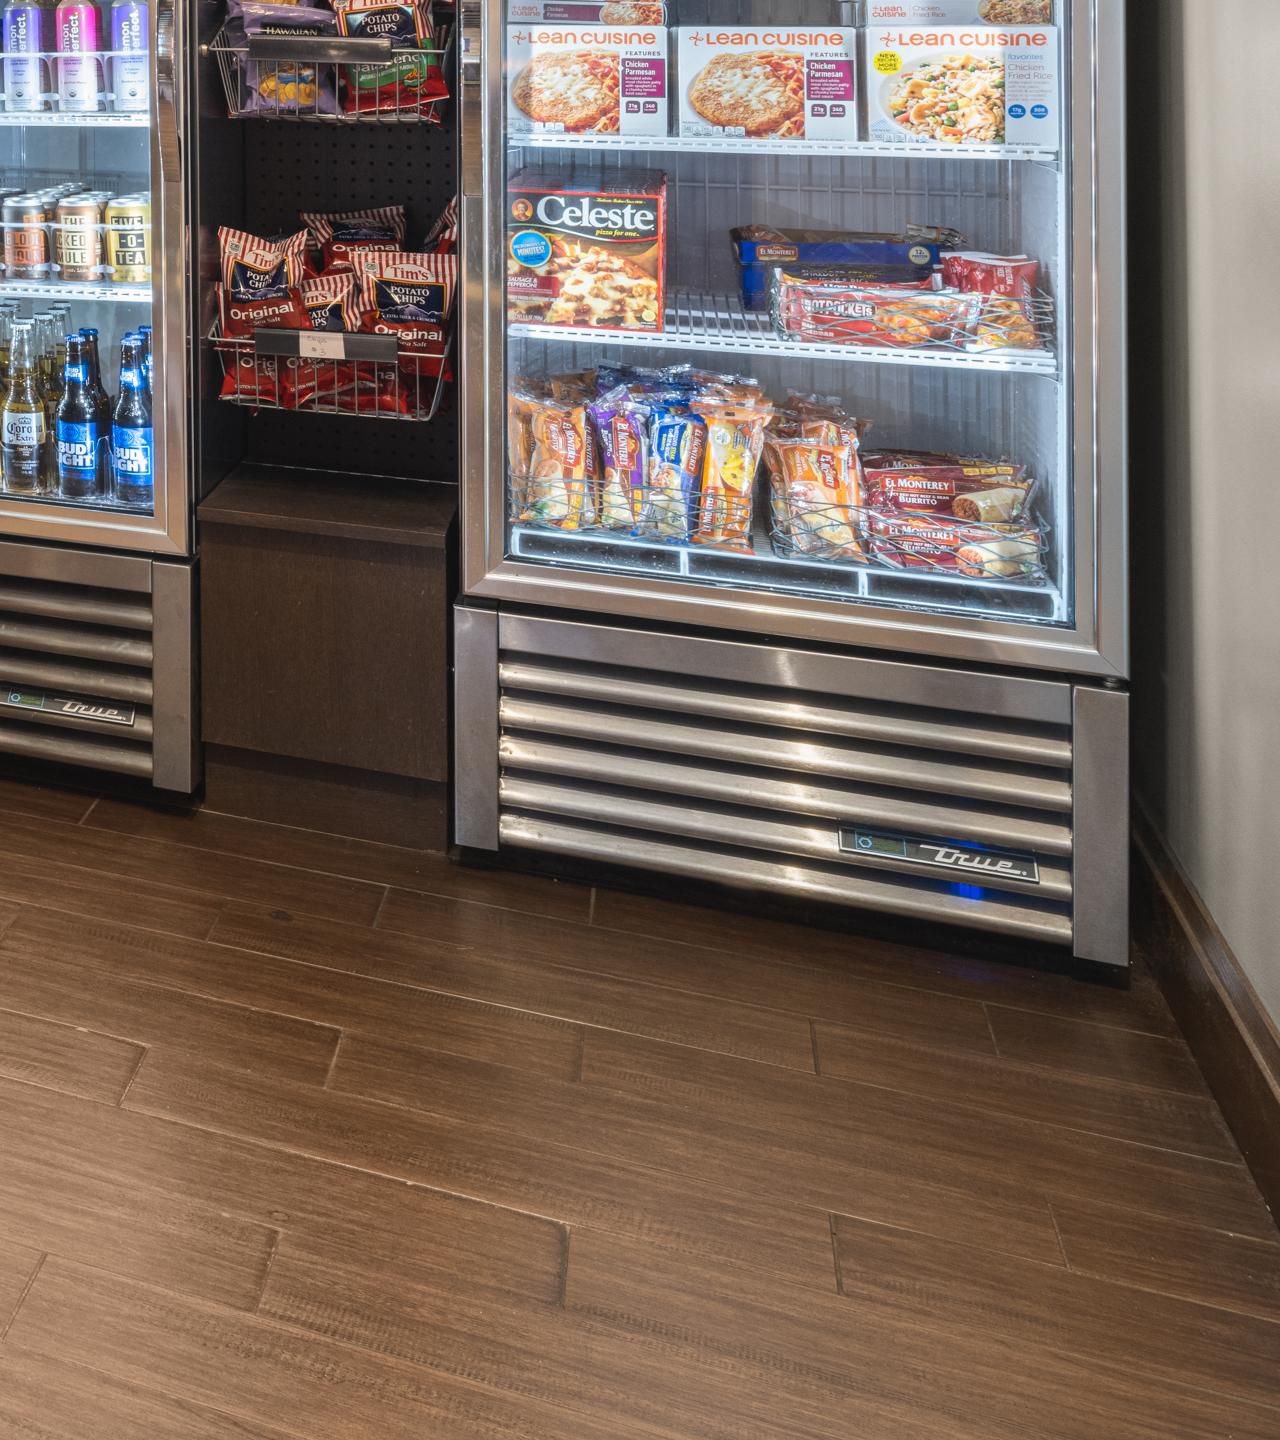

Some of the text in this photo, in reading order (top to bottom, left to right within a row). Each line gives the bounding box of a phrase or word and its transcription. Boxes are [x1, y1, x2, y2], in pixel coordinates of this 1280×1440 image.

[361, 13, 400, 25] POTATO
[265, 27, 317, 36] HAWAIIAN
[366, 23, 397, 34] CHIPS
[1008, 72, 1052, 80] Fried Rice
[537, 195, 655, 231] Celeste
[332, 244, 400, 253] Original
[117, 252, 144, 264] TEA
[390, 266, 429, 281] Tim's
[390, 286, 429, 297] POTATO
[396, 295, 426, 305] CHIPS
[230, 302, 293, 320] Original
[375, 325, 442, 341] Original
[59, 443, 85, 455] BUD
[885, 479, 949, 491] EL MONTEREY
[898, 495, 937, 505] BURRITO
